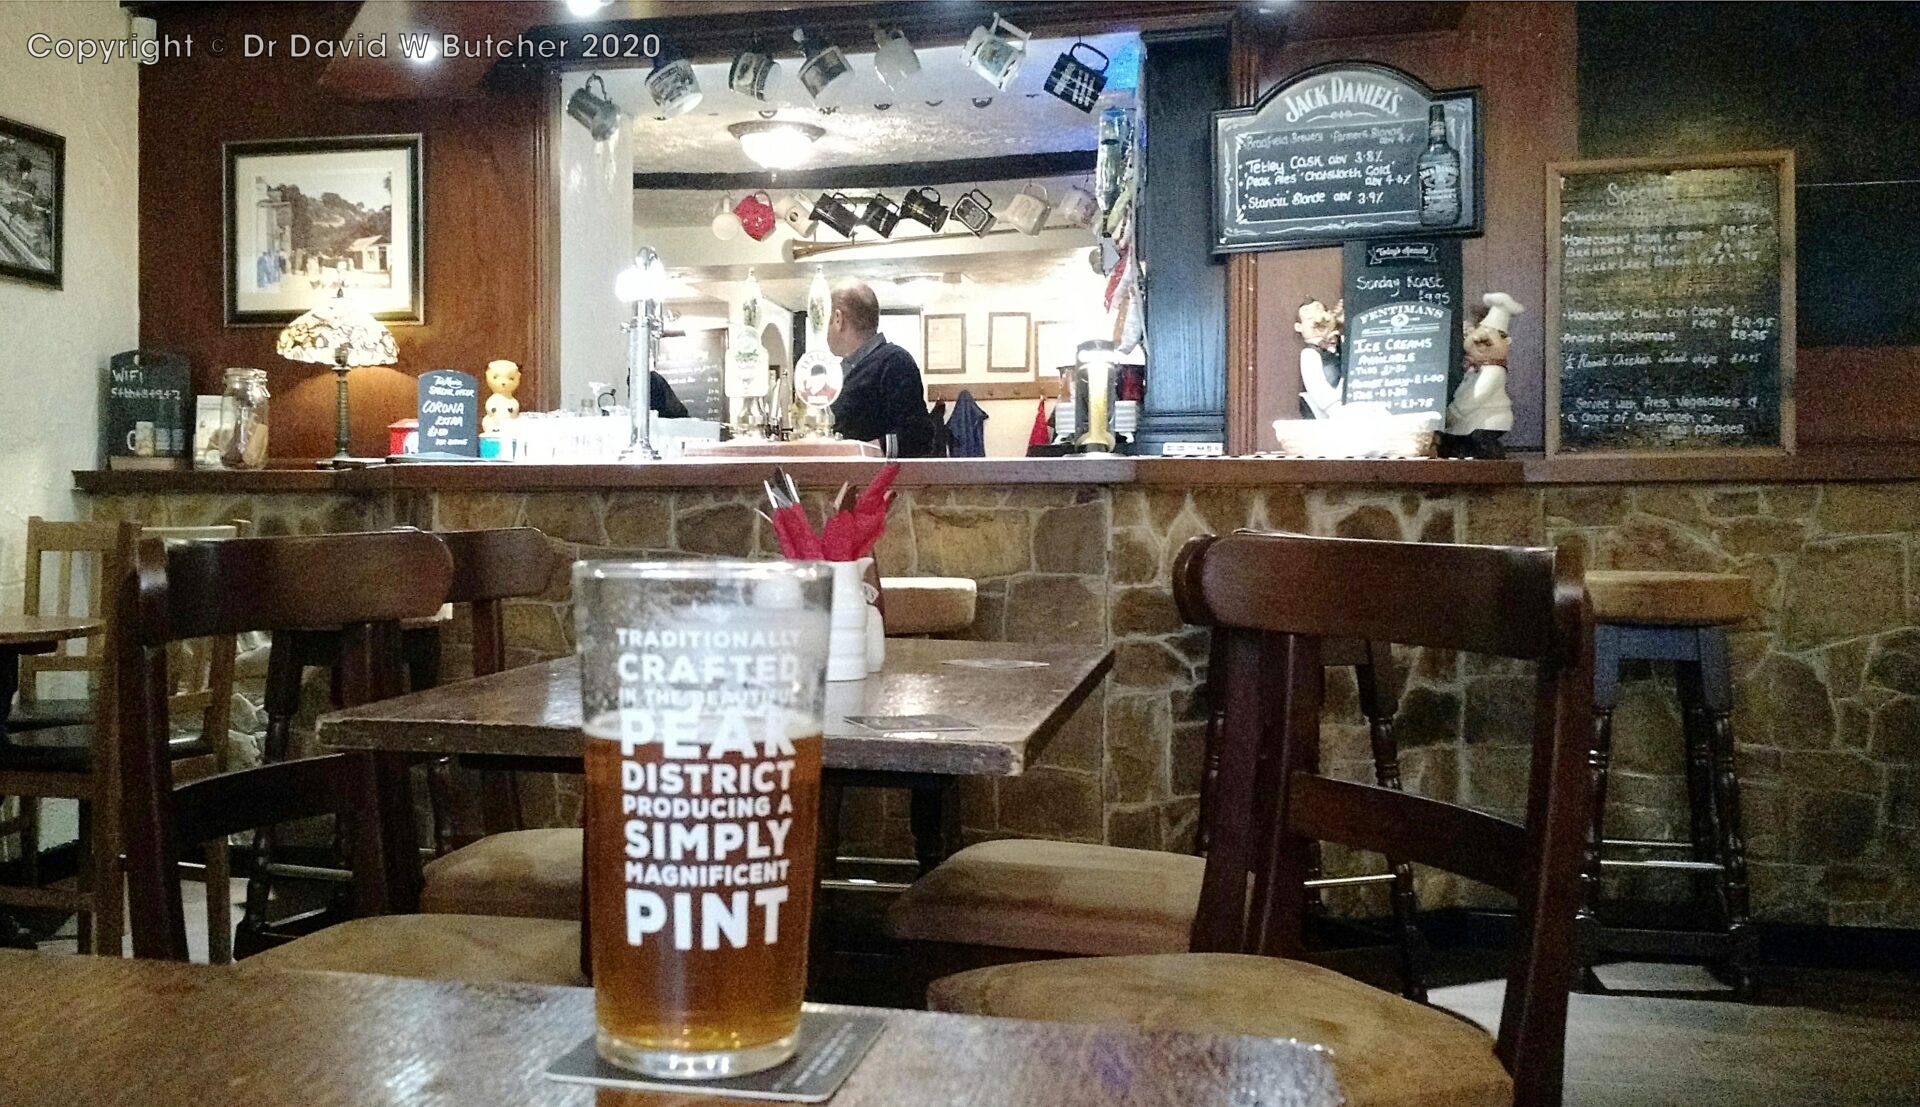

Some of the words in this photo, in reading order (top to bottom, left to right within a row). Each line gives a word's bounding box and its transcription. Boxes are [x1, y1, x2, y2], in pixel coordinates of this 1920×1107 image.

[1285, 84, 1329, 123] JACK
[1245, 159, 1284, 176] Tetley
[1328, 154, 1347, 165] abv
[1274, 174, 1297, 185] Ales
[1292, 192, 1326, 205] Blonde
[1333, 191, 1352, 202] abv
[1356, 275, 1400, 297] Sunday
[1360, 304, 1444, 324] FENTIMANS
[422, 400, 464, 414] CORONA
[616, 627, 801, 649] TRADITIONALLY
[617, 653, 799, 684] CRAFTED
[620, 708, 796, 759] PEAK
[620, 760, 796, 795] DISTRICT
[622, 795, 771, 820] PRODUCING
[777, 794, 793, 815] A
[624, 817, 793, 862] SIMPLY
[625, 859, 790, 888] MAGNIFICENT
[625, 885, 790, 951] PINT
